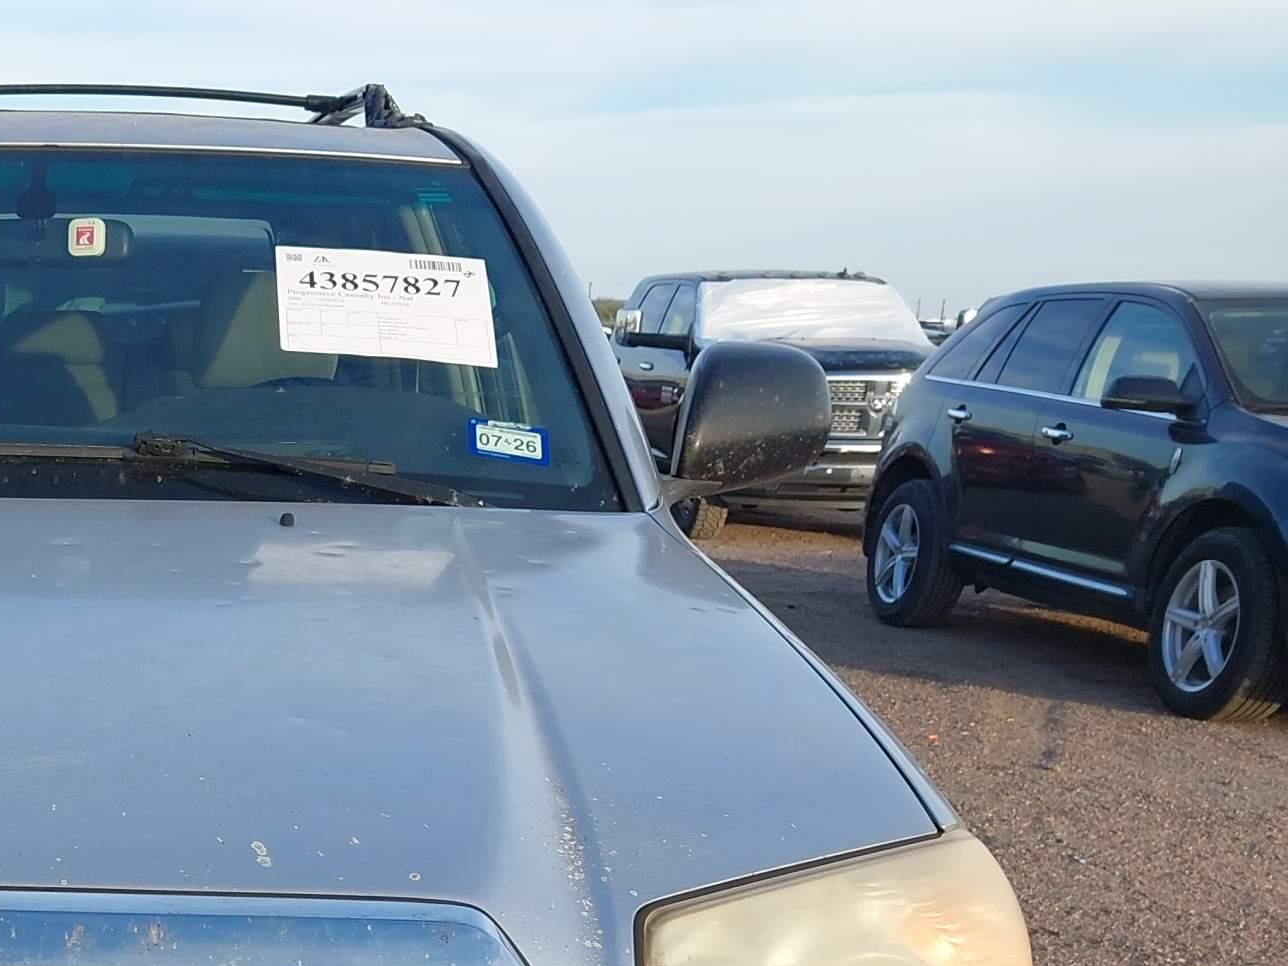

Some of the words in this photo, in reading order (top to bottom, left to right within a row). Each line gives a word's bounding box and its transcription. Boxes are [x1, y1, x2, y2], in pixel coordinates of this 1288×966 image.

[299, 270, 461, 298] 43857827
[479, 433, 502, 447] 07
[513, 438, 537, 453] 26
